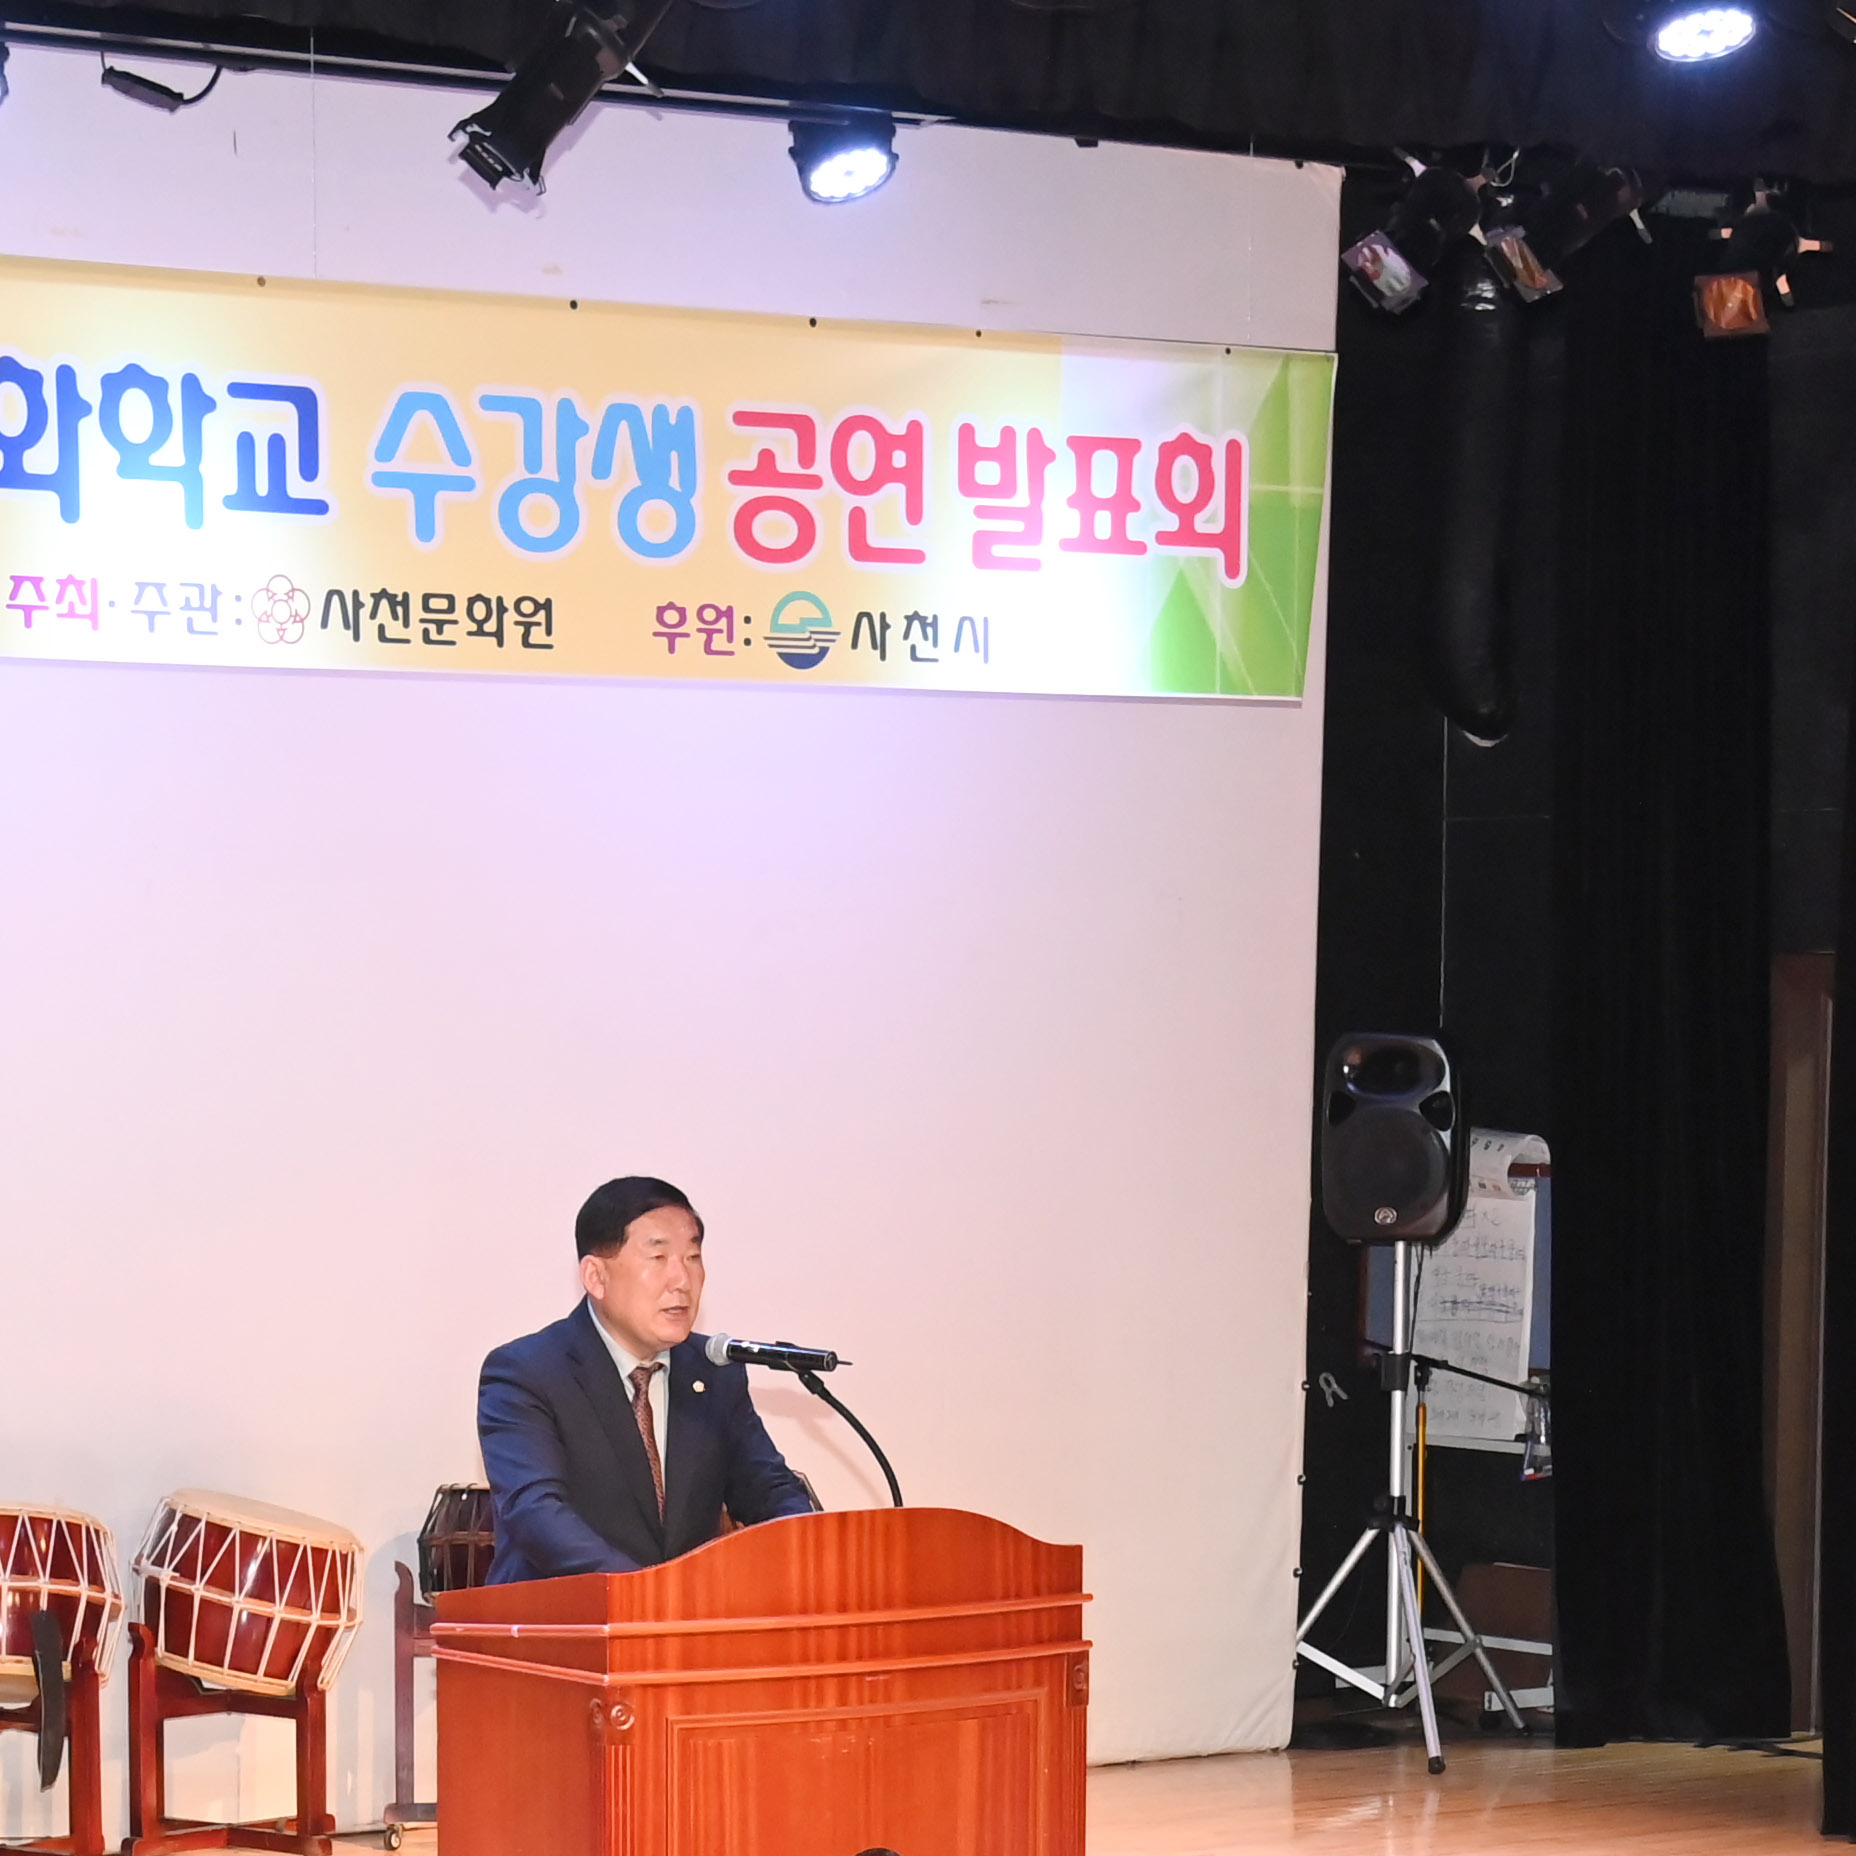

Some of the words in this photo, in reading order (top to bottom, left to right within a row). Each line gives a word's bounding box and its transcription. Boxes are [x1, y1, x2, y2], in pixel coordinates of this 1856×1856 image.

[370, 391, 697, 559] 수강생
[727, 410, 926, 565] 공연
[957, 421, 1243, 580] 발표회
[320, 588, 555, 650] 사천문화원
[652, 600, 752, 657] 후원:
[850, 610, 990, 664] 사천시
